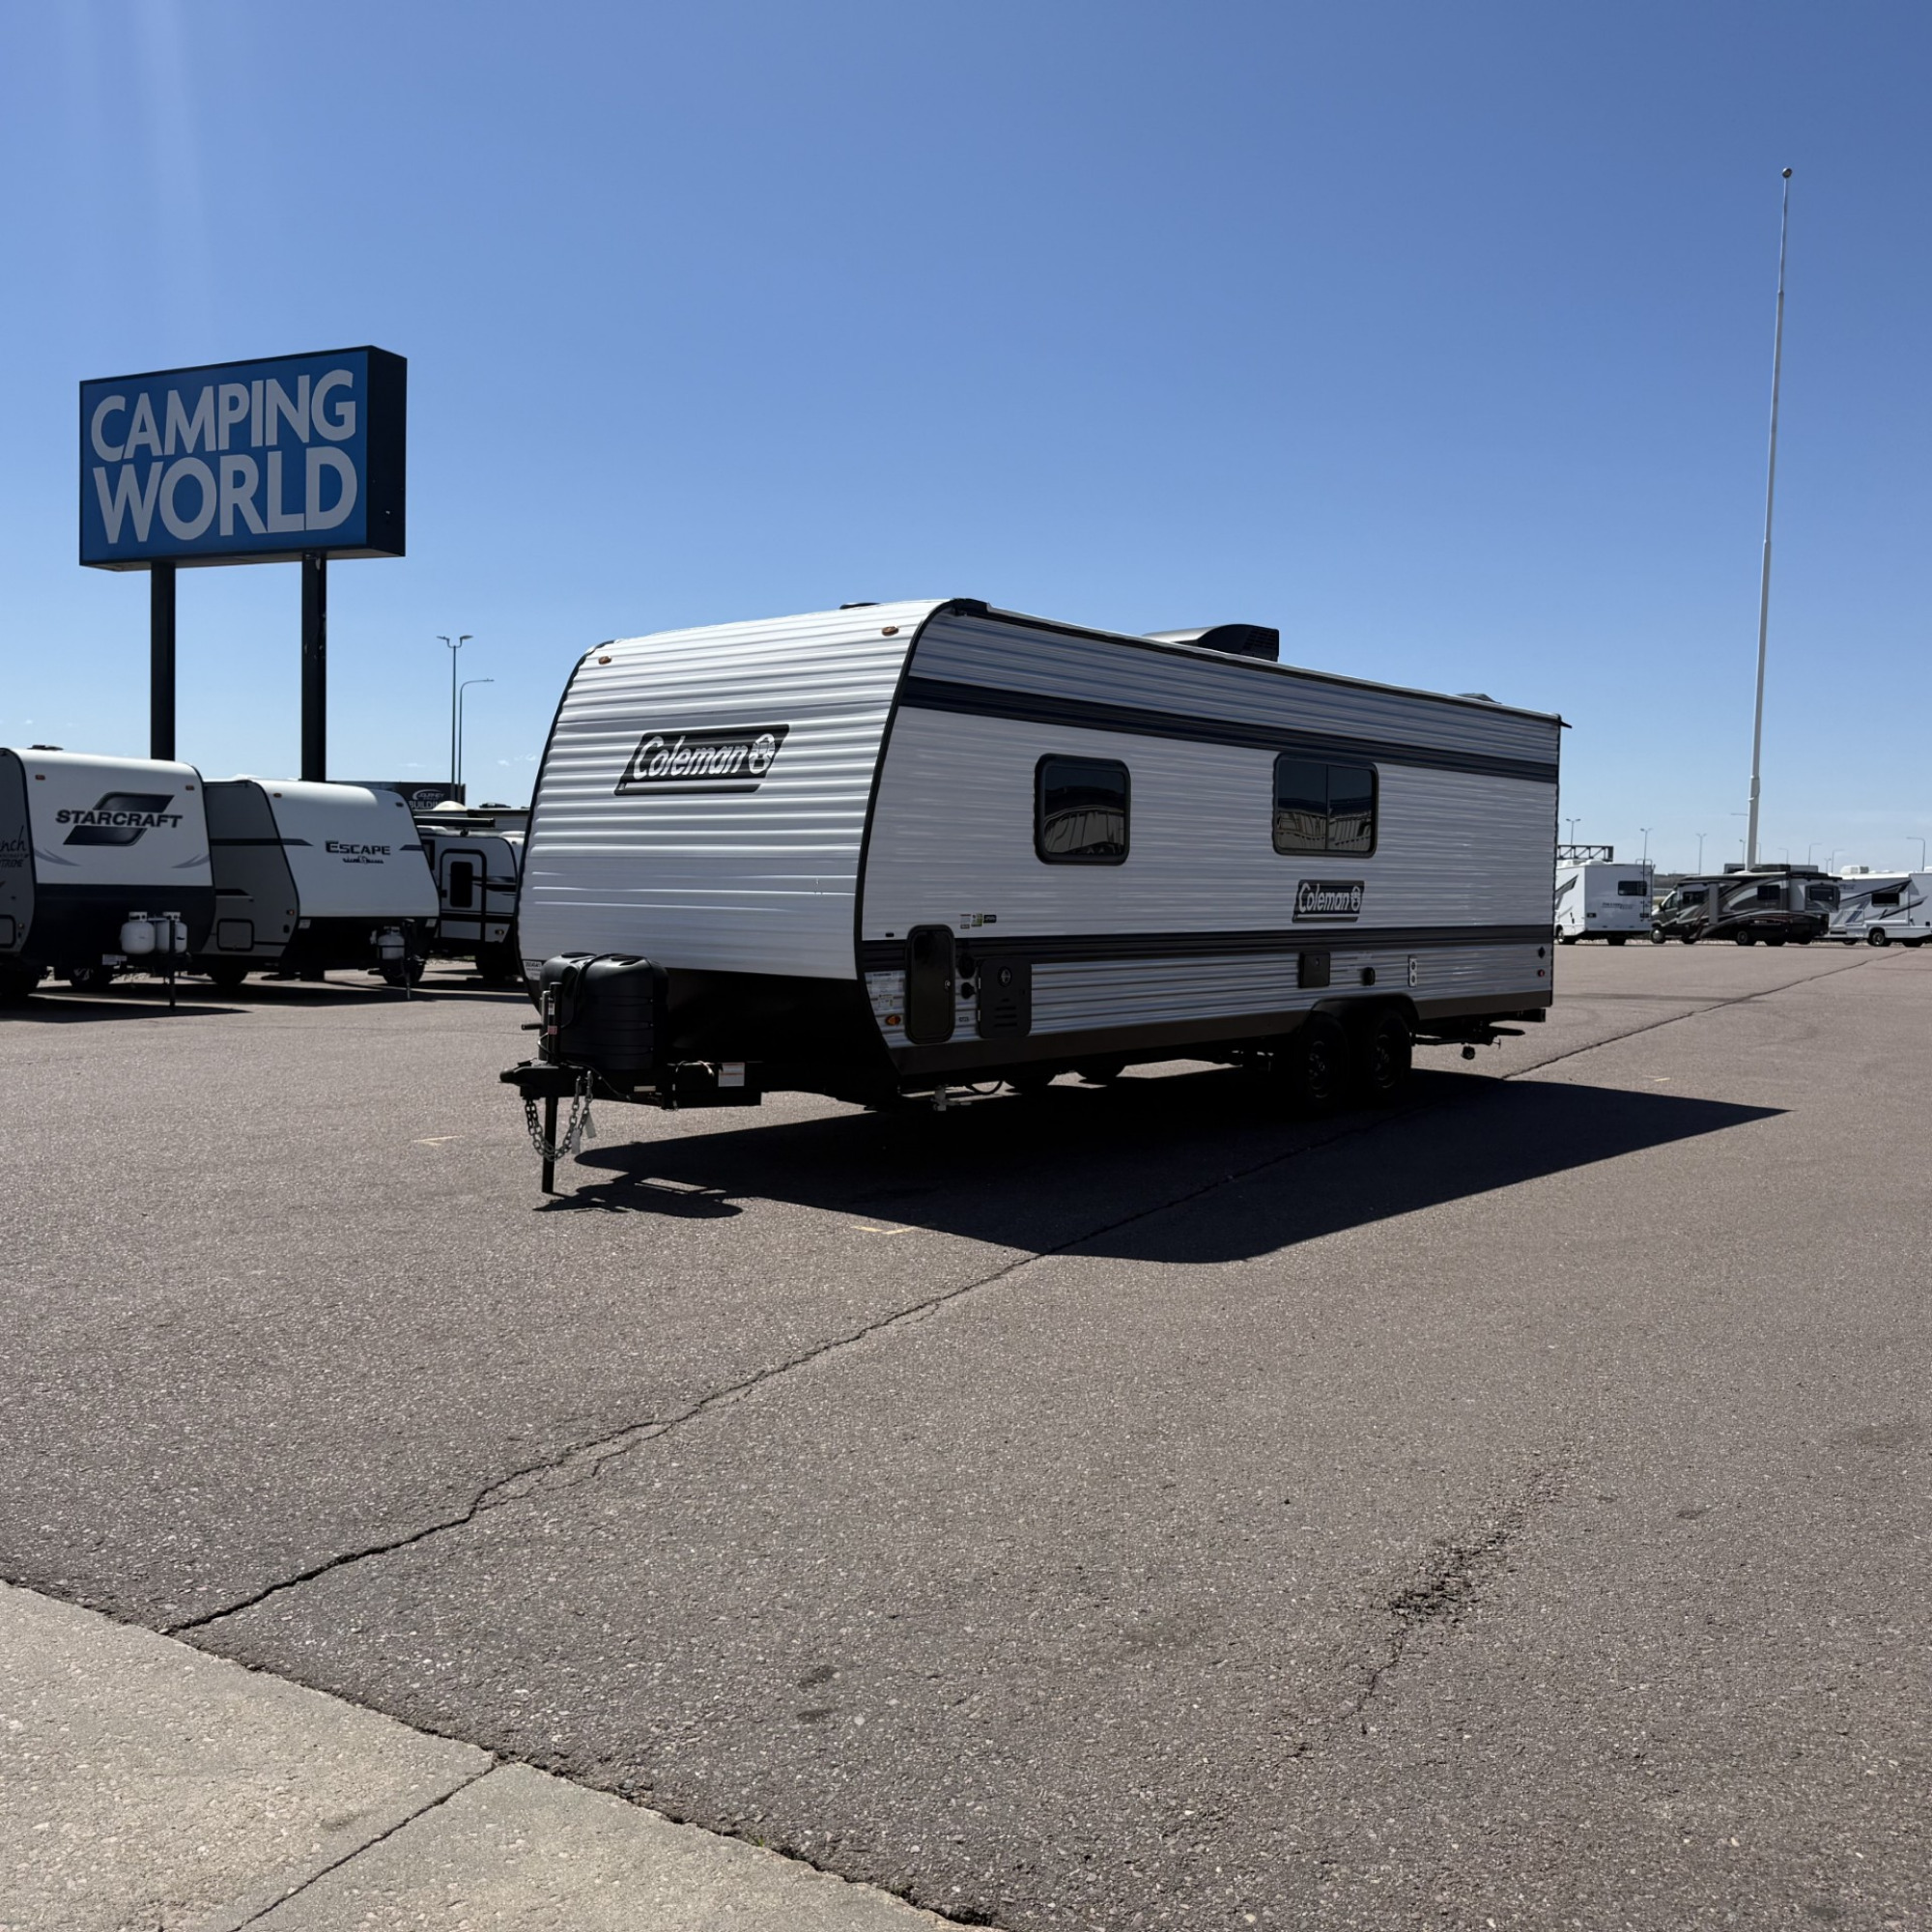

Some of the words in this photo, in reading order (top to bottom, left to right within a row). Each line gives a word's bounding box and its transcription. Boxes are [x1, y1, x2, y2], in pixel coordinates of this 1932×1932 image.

[91, 369, 355, 462] CAMPING
[93, 445, 357, 544] WORLD
[633, 734, 749, 780] Coleman
[55, 810, 183, 829] STARCRAFT
[409, 800, 438, 809] BUILDI
[1298, 882, 1350, 913] Coleman
